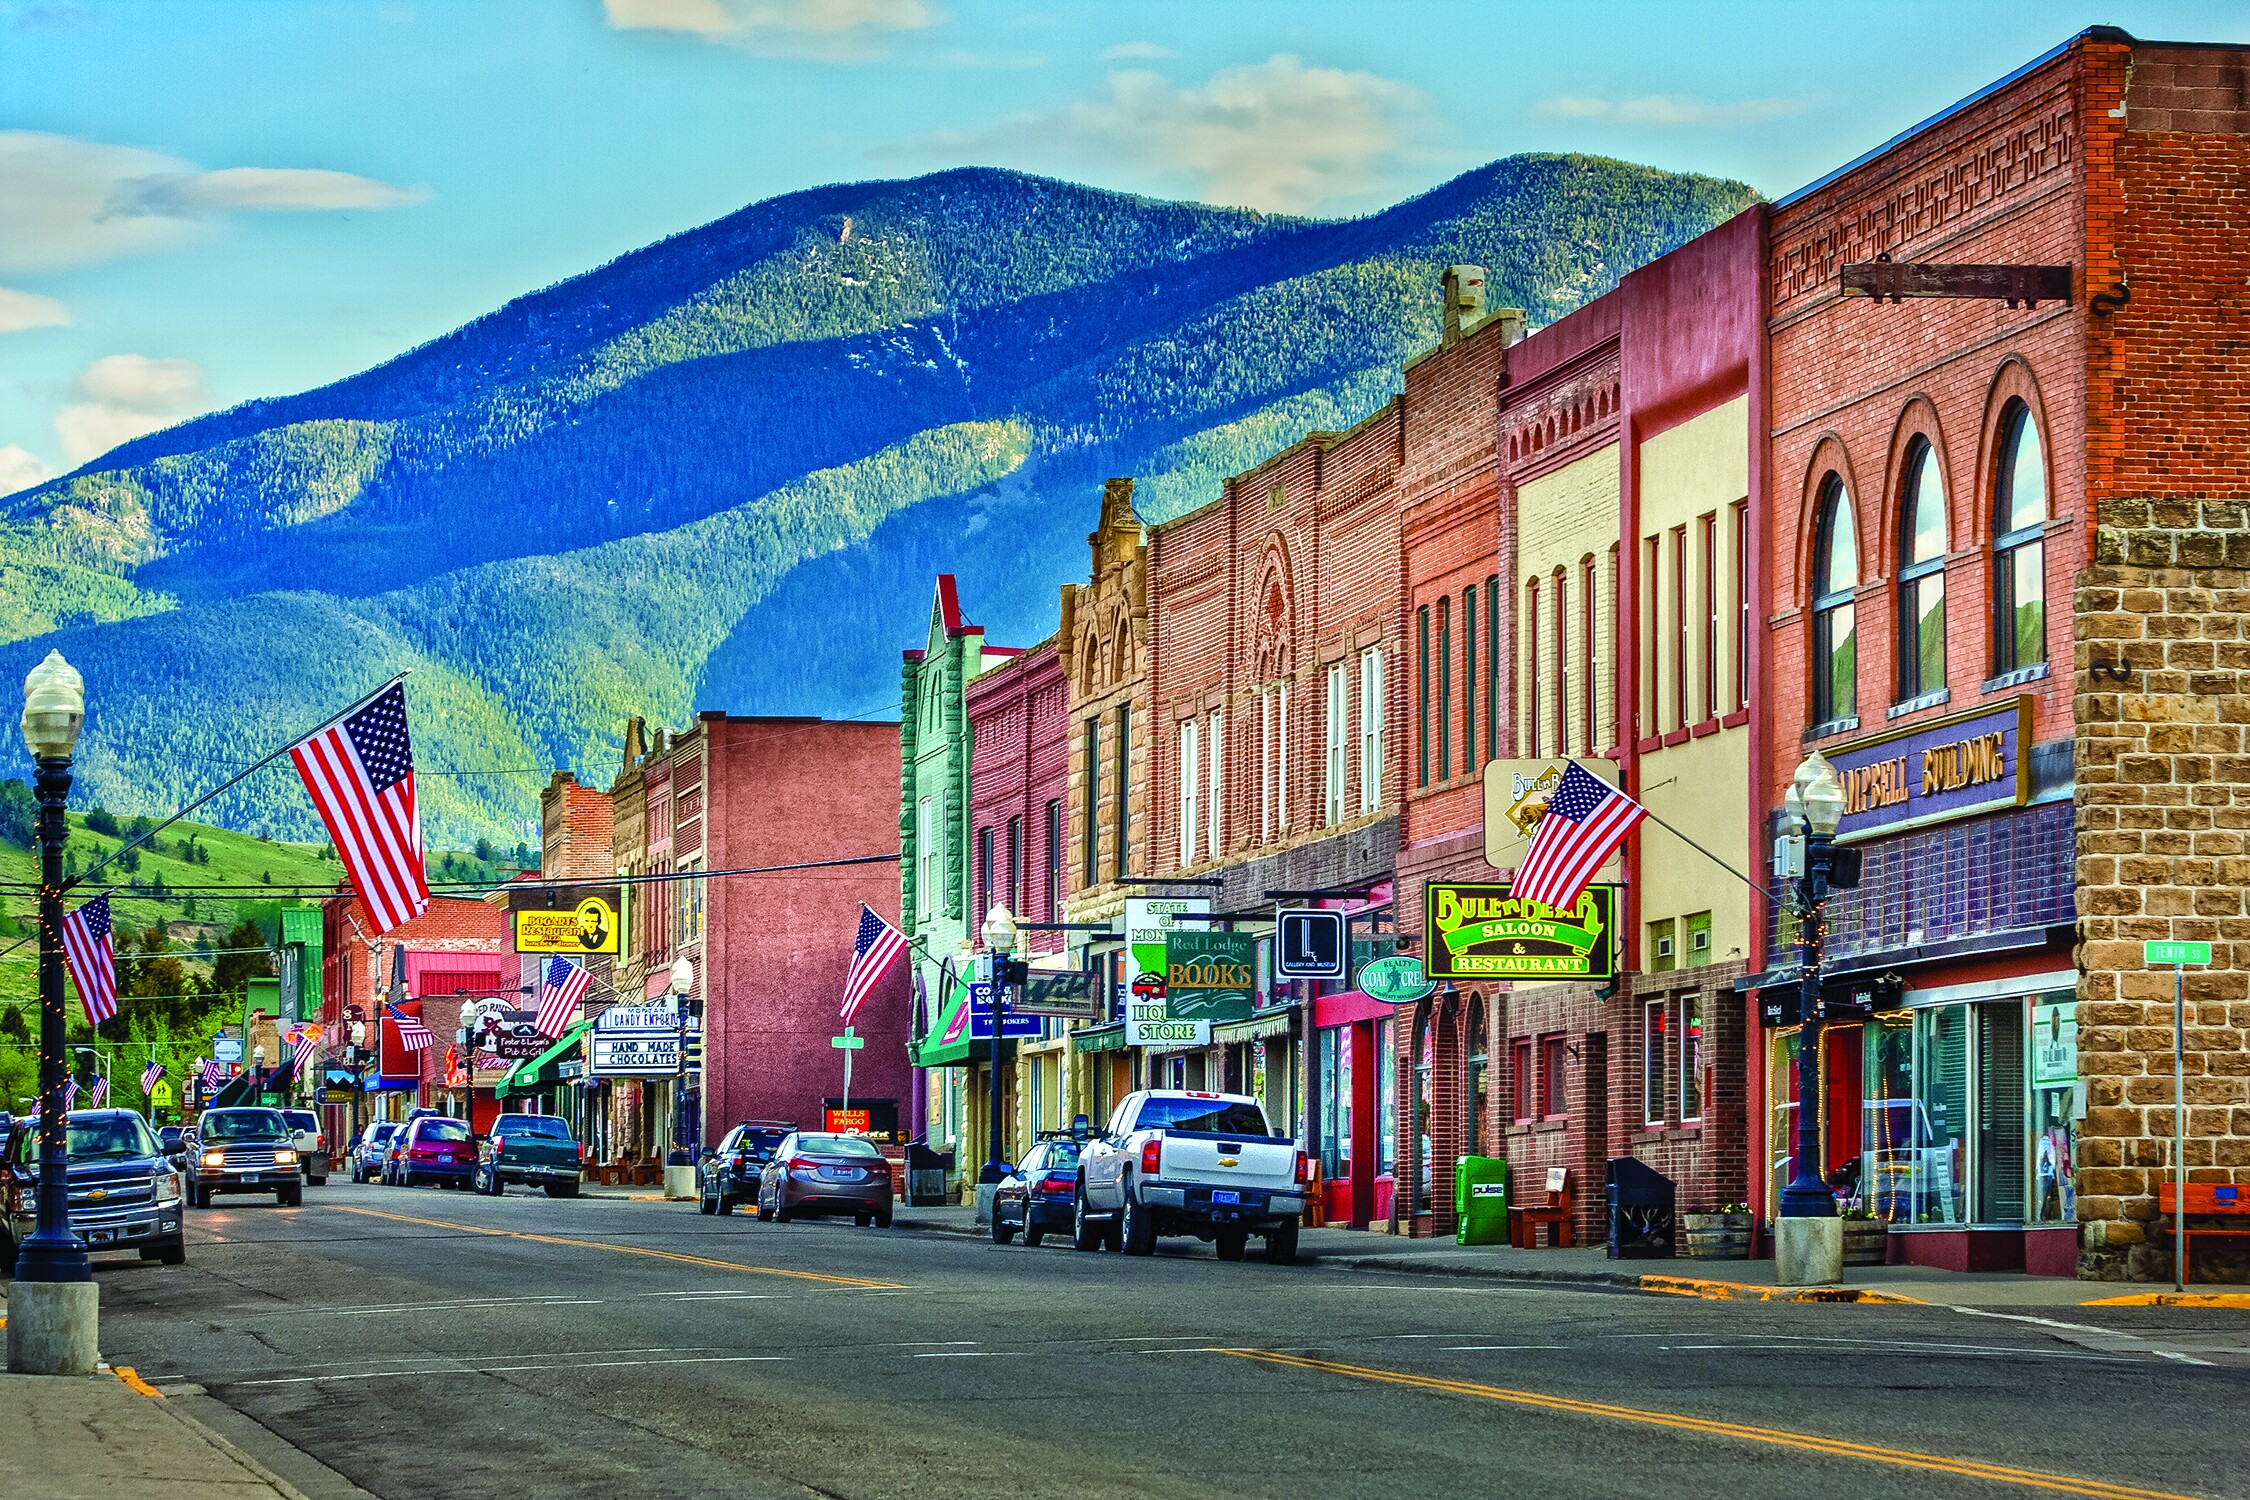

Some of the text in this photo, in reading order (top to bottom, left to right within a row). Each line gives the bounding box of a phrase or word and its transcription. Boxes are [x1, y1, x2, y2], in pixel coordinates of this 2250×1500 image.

[1921, 731, 2004, 796] BUILDING
[1146, 902, 1188, 914] STATE
[528, 916, 578, 926] BOGARTS
[522, 924, 585, 936] Restaurant
[1482, 922, 1557, 937] SALOON
[1173, 937, 1247, 955] Red Lodge
[1512, 943, 1526, 955] &
[2155, 945, 2201, 959] TENTH ST
[1383, 960, 1413, 968] REALTY
[1458, 957, 1583, 972] RESTAURANT
[1168, 963, 1252, 986] BOOKS
[1362, 971, 1433, 987] COAL CRE
[614, 1013, 680, 1026] CANDY EMPORIU
[1138, 1023, 1196, 1040] STORE
[500, 1038, 520, 1046] Foster
[527, 1038, 549, 1046] Logan's
[612, 1041, 675, 1053] HAND MADE
[521, 1047, 528, 1055] &
[529, 1047, 545, 1057] Grill
[609, 1053, 677, 1065] CHOCOLATES
[1473, 1185, 1503, 1196] pulse
